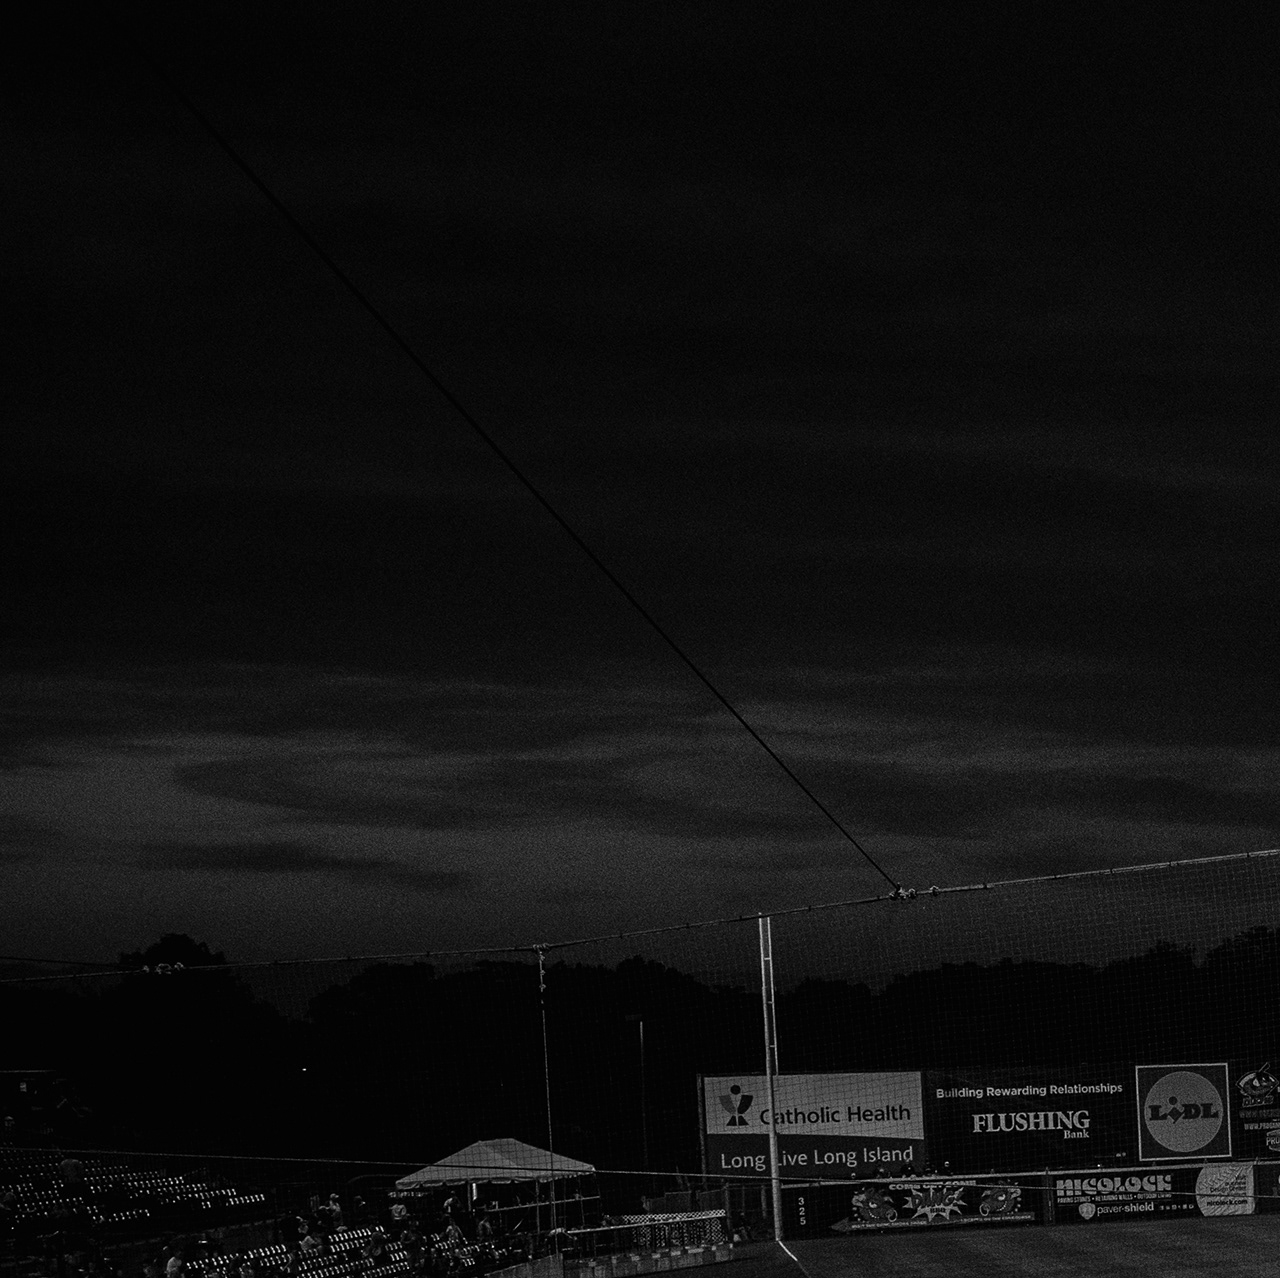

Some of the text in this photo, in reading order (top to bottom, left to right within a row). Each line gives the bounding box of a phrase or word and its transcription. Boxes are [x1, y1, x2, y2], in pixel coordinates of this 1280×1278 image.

[936, 1083, 1123, 1099] Building Rewarding Relationships
[848, 1104, 911, 1122] Health
[972, 1110, 1091, 1133] FLUSHING
[1063, 1129, 1090, 1140] Bank
[720, 1146, 914, 1172] Long Long Island
[1096, 1201, 1155, 1217] paver-shield
